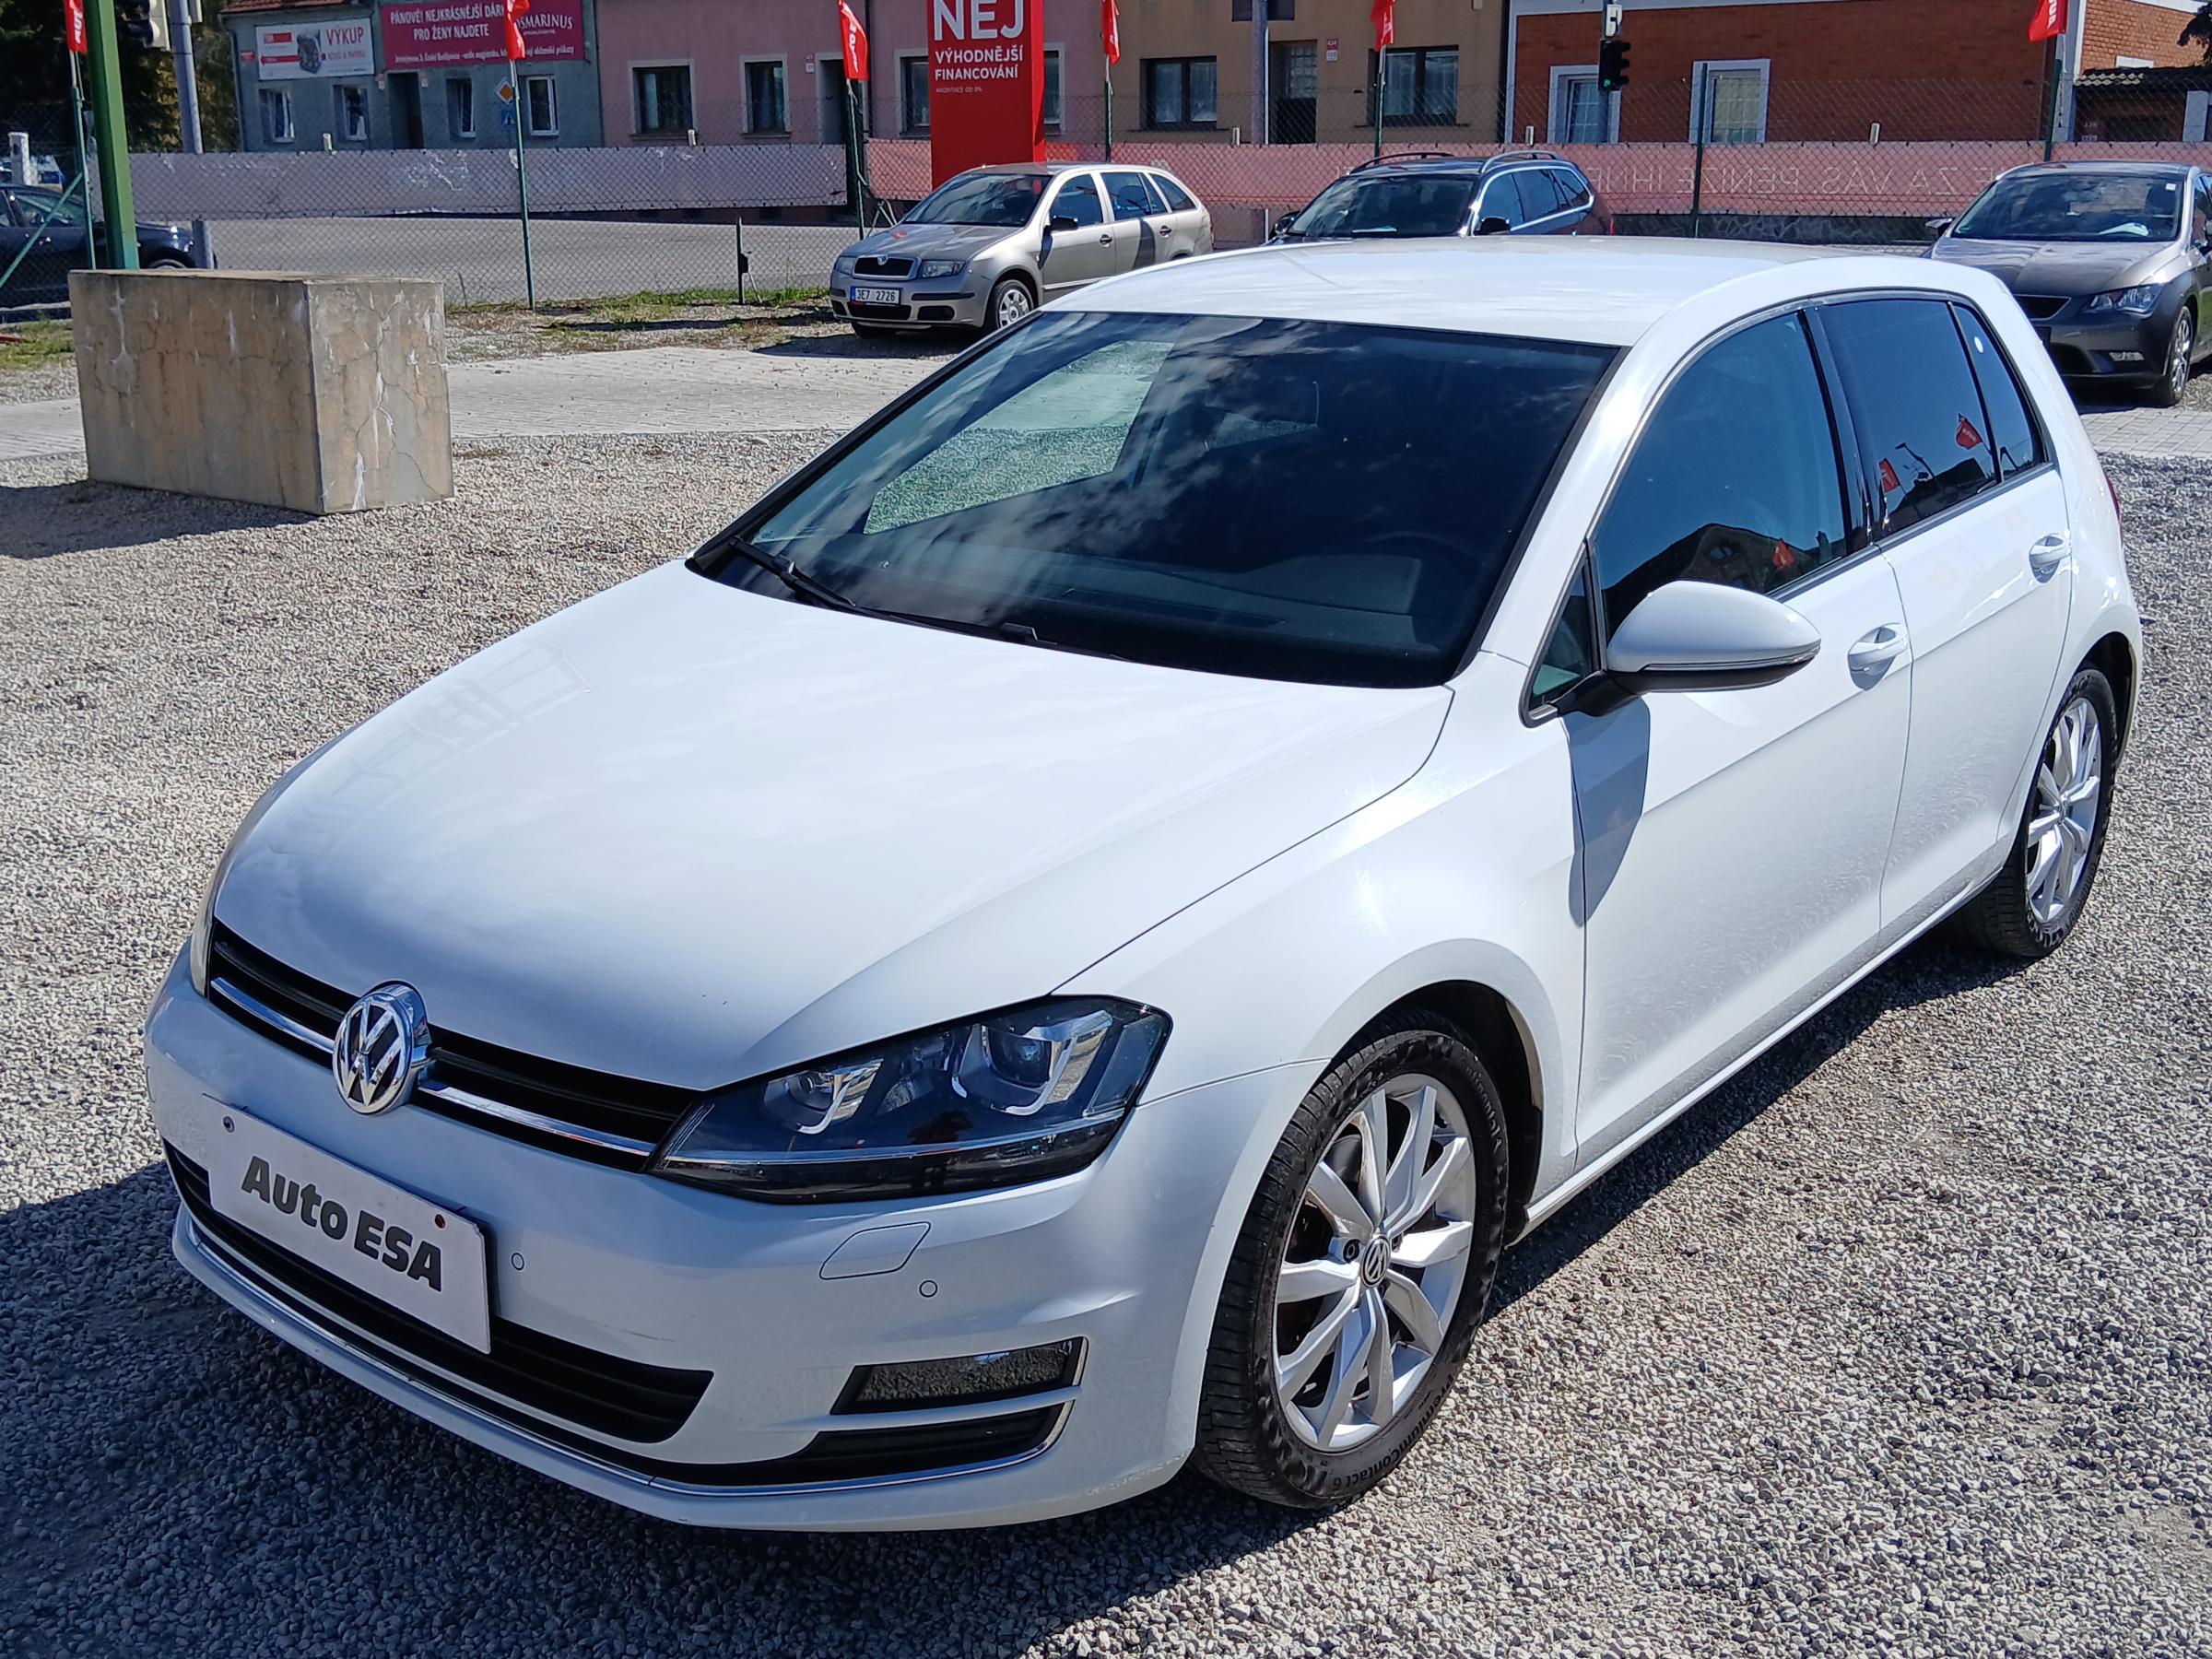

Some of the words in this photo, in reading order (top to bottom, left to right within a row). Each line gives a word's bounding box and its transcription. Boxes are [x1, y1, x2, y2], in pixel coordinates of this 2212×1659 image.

[426, 4, 483, 21] NEJKRÁSNĚJŠÍ
[934, 0, 1024, 41] NEJ
[326, 24, 364, 45] VÝKUP
[414, 27, 429, 41] PRO
[431, 25, 453, 40] ŽENY
[454, 23, 489, 38] NAJDETE
[935, 44, 1024, 64] VÝHODNĚJŠÍ
[935, 64, 1018, 81] FINANCOVÁNÍ
[857, 289, 870, 300] 3E7
[876, 290, 896, 301] 2726
[241, 1155, 348, 1241] Auto
[353, 1210, 443, 1293] ESA
